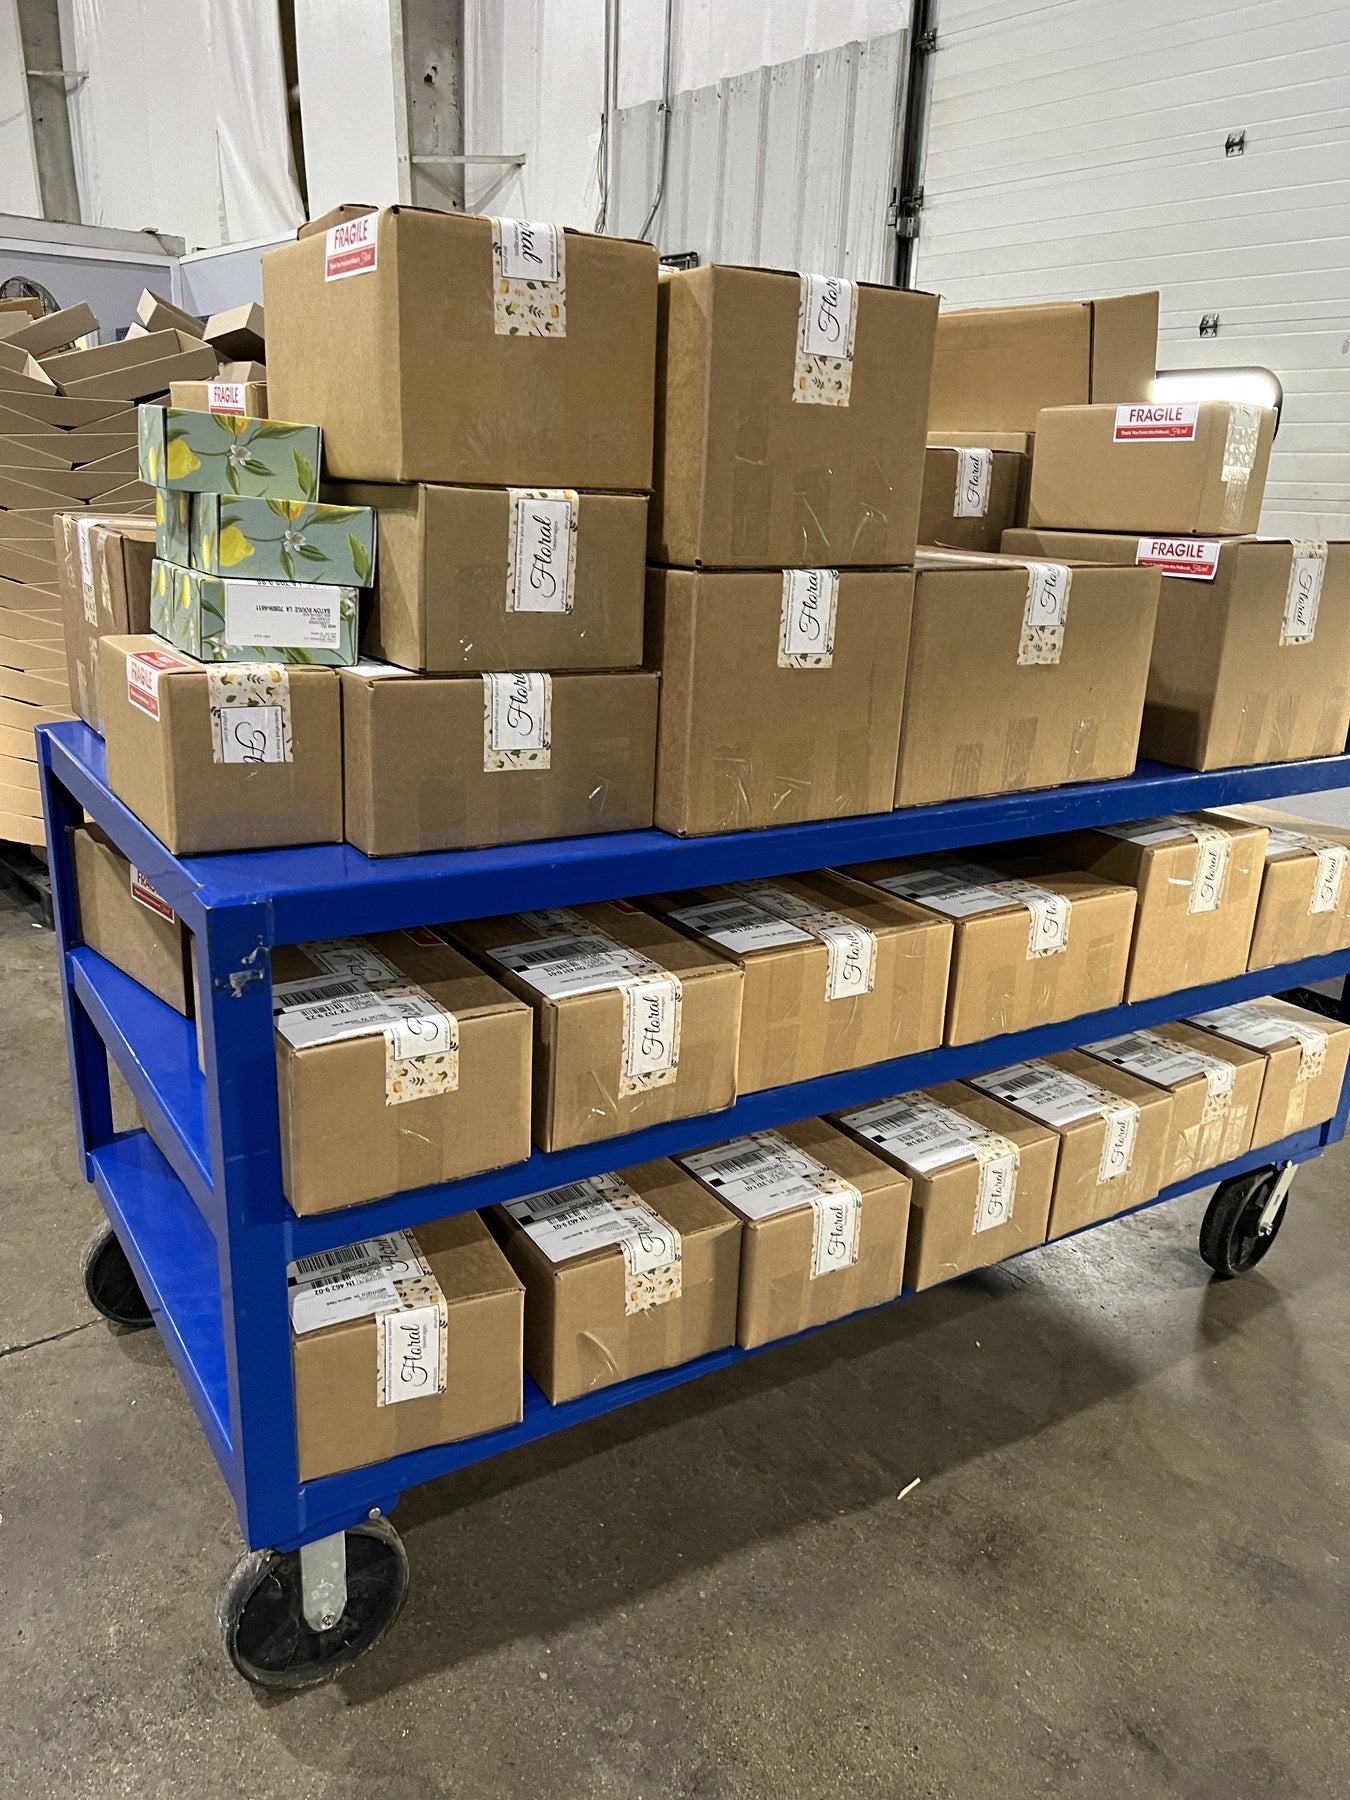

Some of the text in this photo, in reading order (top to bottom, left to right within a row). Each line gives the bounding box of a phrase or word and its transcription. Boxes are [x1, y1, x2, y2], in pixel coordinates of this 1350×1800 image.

[334, 219, 368, 249] FRAGILE
[213, 386, 239, 403] FRAGILE
[1129, 407, 1184, 423] FRAGILE
[966, 454, 981, 509] Floral
[530, 514, 557, 598] Floral
[1150, 541, 1205, 559] FRAGILE
[295, 606, 313, 614] ROUGE
[1297, 567, 1313, 627] Floral
[131, 661, 153, 690] FRAGILE
[1201, 850, 1217, 903] Floral
[1320, 857, 1337, 904] Floral
[834, 932, 862, 986] Floral
[641, 995, 665, 1061] Floral
[1110, 1119, 1127, 1168] Floral
[988, 1168, 1004, 1219] Floral
[827, 1204, 846, 1260] Floral
[313, 1287, 331, 1296] 9-02
[331, 1283, 345, 1291] 462
[400, 1323, 428, 1387] Floral
